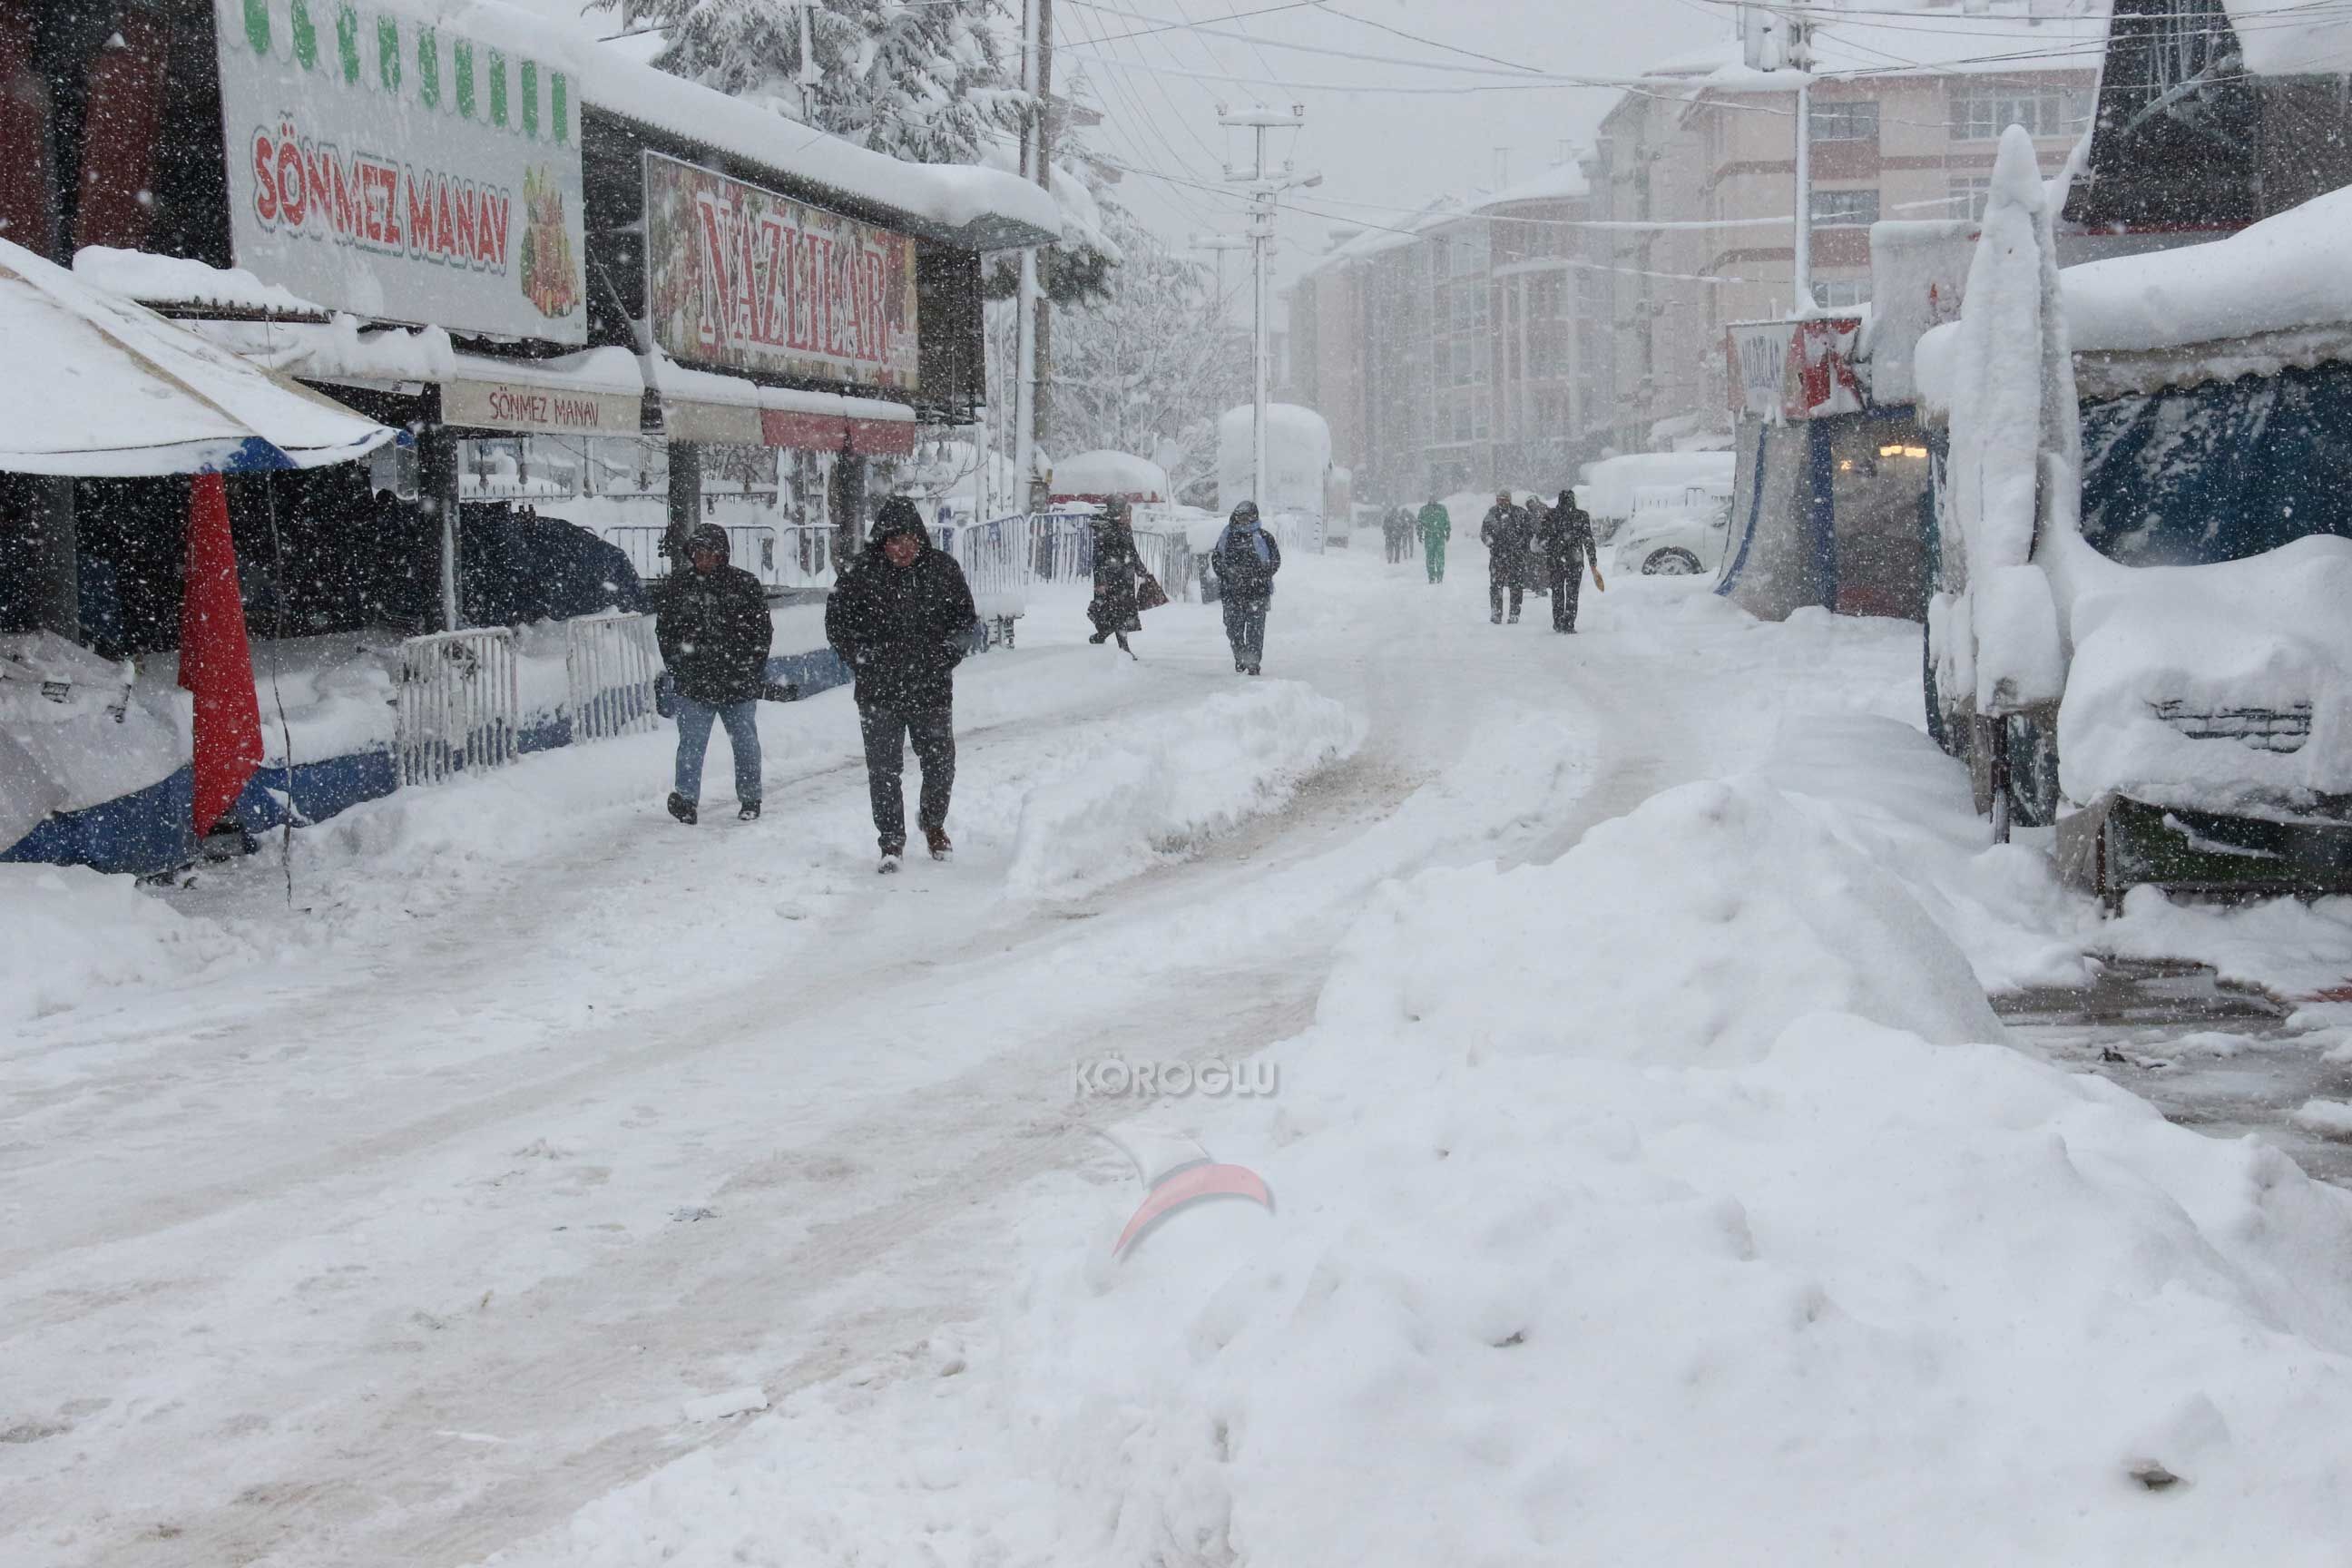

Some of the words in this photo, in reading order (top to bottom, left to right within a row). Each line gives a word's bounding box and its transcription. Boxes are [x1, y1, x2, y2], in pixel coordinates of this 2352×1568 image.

[254, 119, 404, 248] SÖNMEZ
[407, 173, 510, 268] MANAV
[696, 192, 887, 365] NAZLILAR
[488, 387, 547, 423] SÖNMEZ
[554, 397, 600, 427] MANAV
